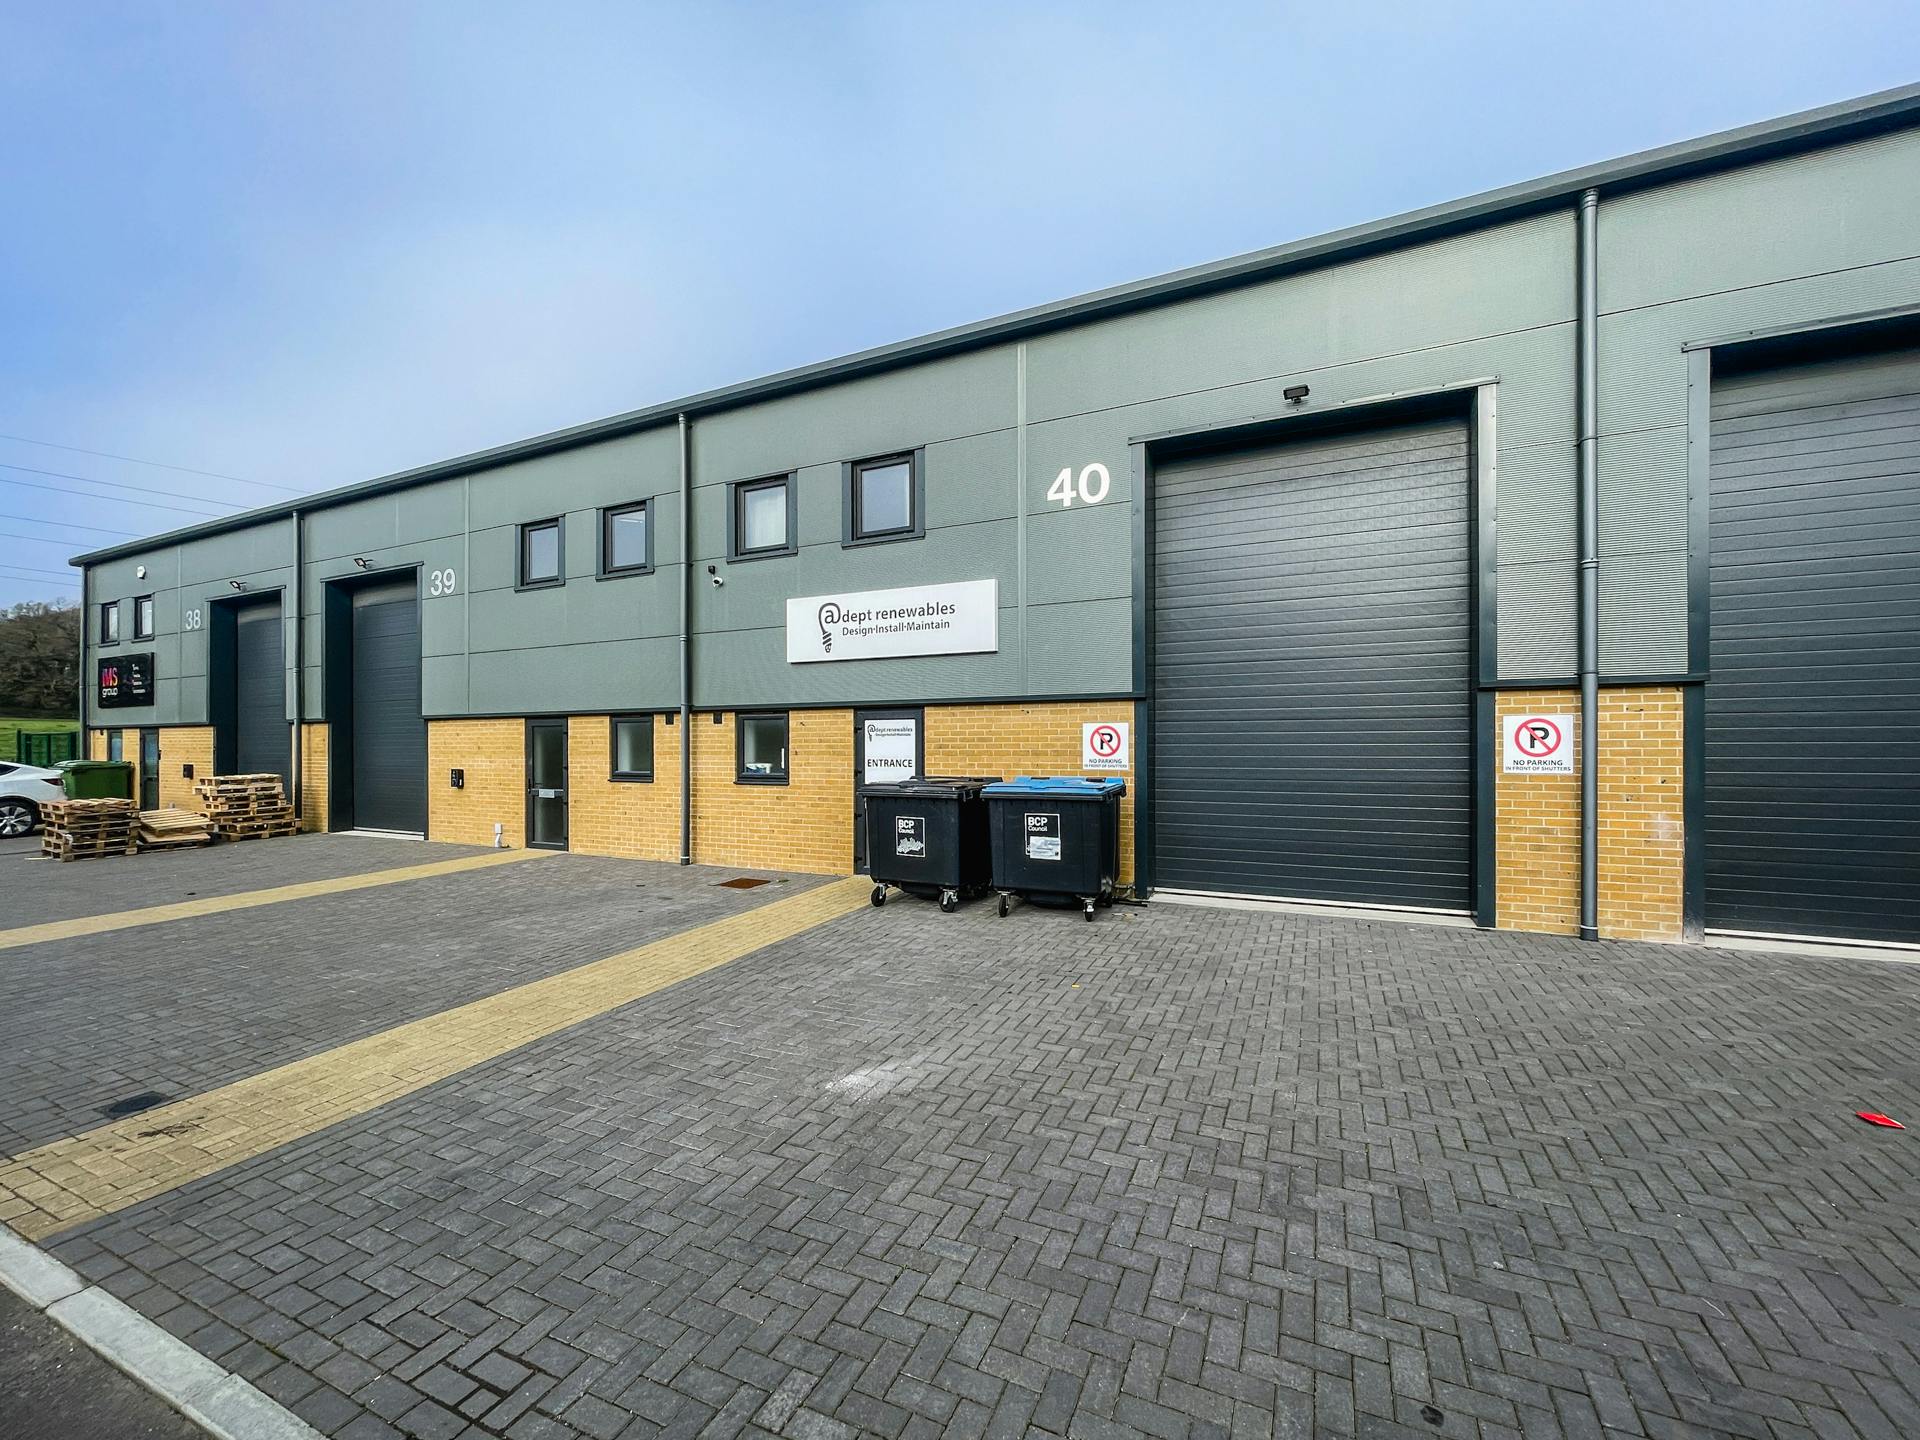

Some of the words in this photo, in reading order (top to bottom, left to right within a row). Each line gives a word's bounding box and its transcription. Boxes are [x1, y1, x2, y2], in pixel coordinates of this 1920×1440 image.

[1047, 463, 1110, 507] 40
[431, 568, 455, 595] 39
[876, 601, 956, 620] renewables
[186, 609, 201, 630] 38
[102, 687, 119, 698] group
[867, 759, 913, 768] ENTRANCE
[898, 819, 914, 828] BCP
[1027, 817, 1048, 826] BCP
